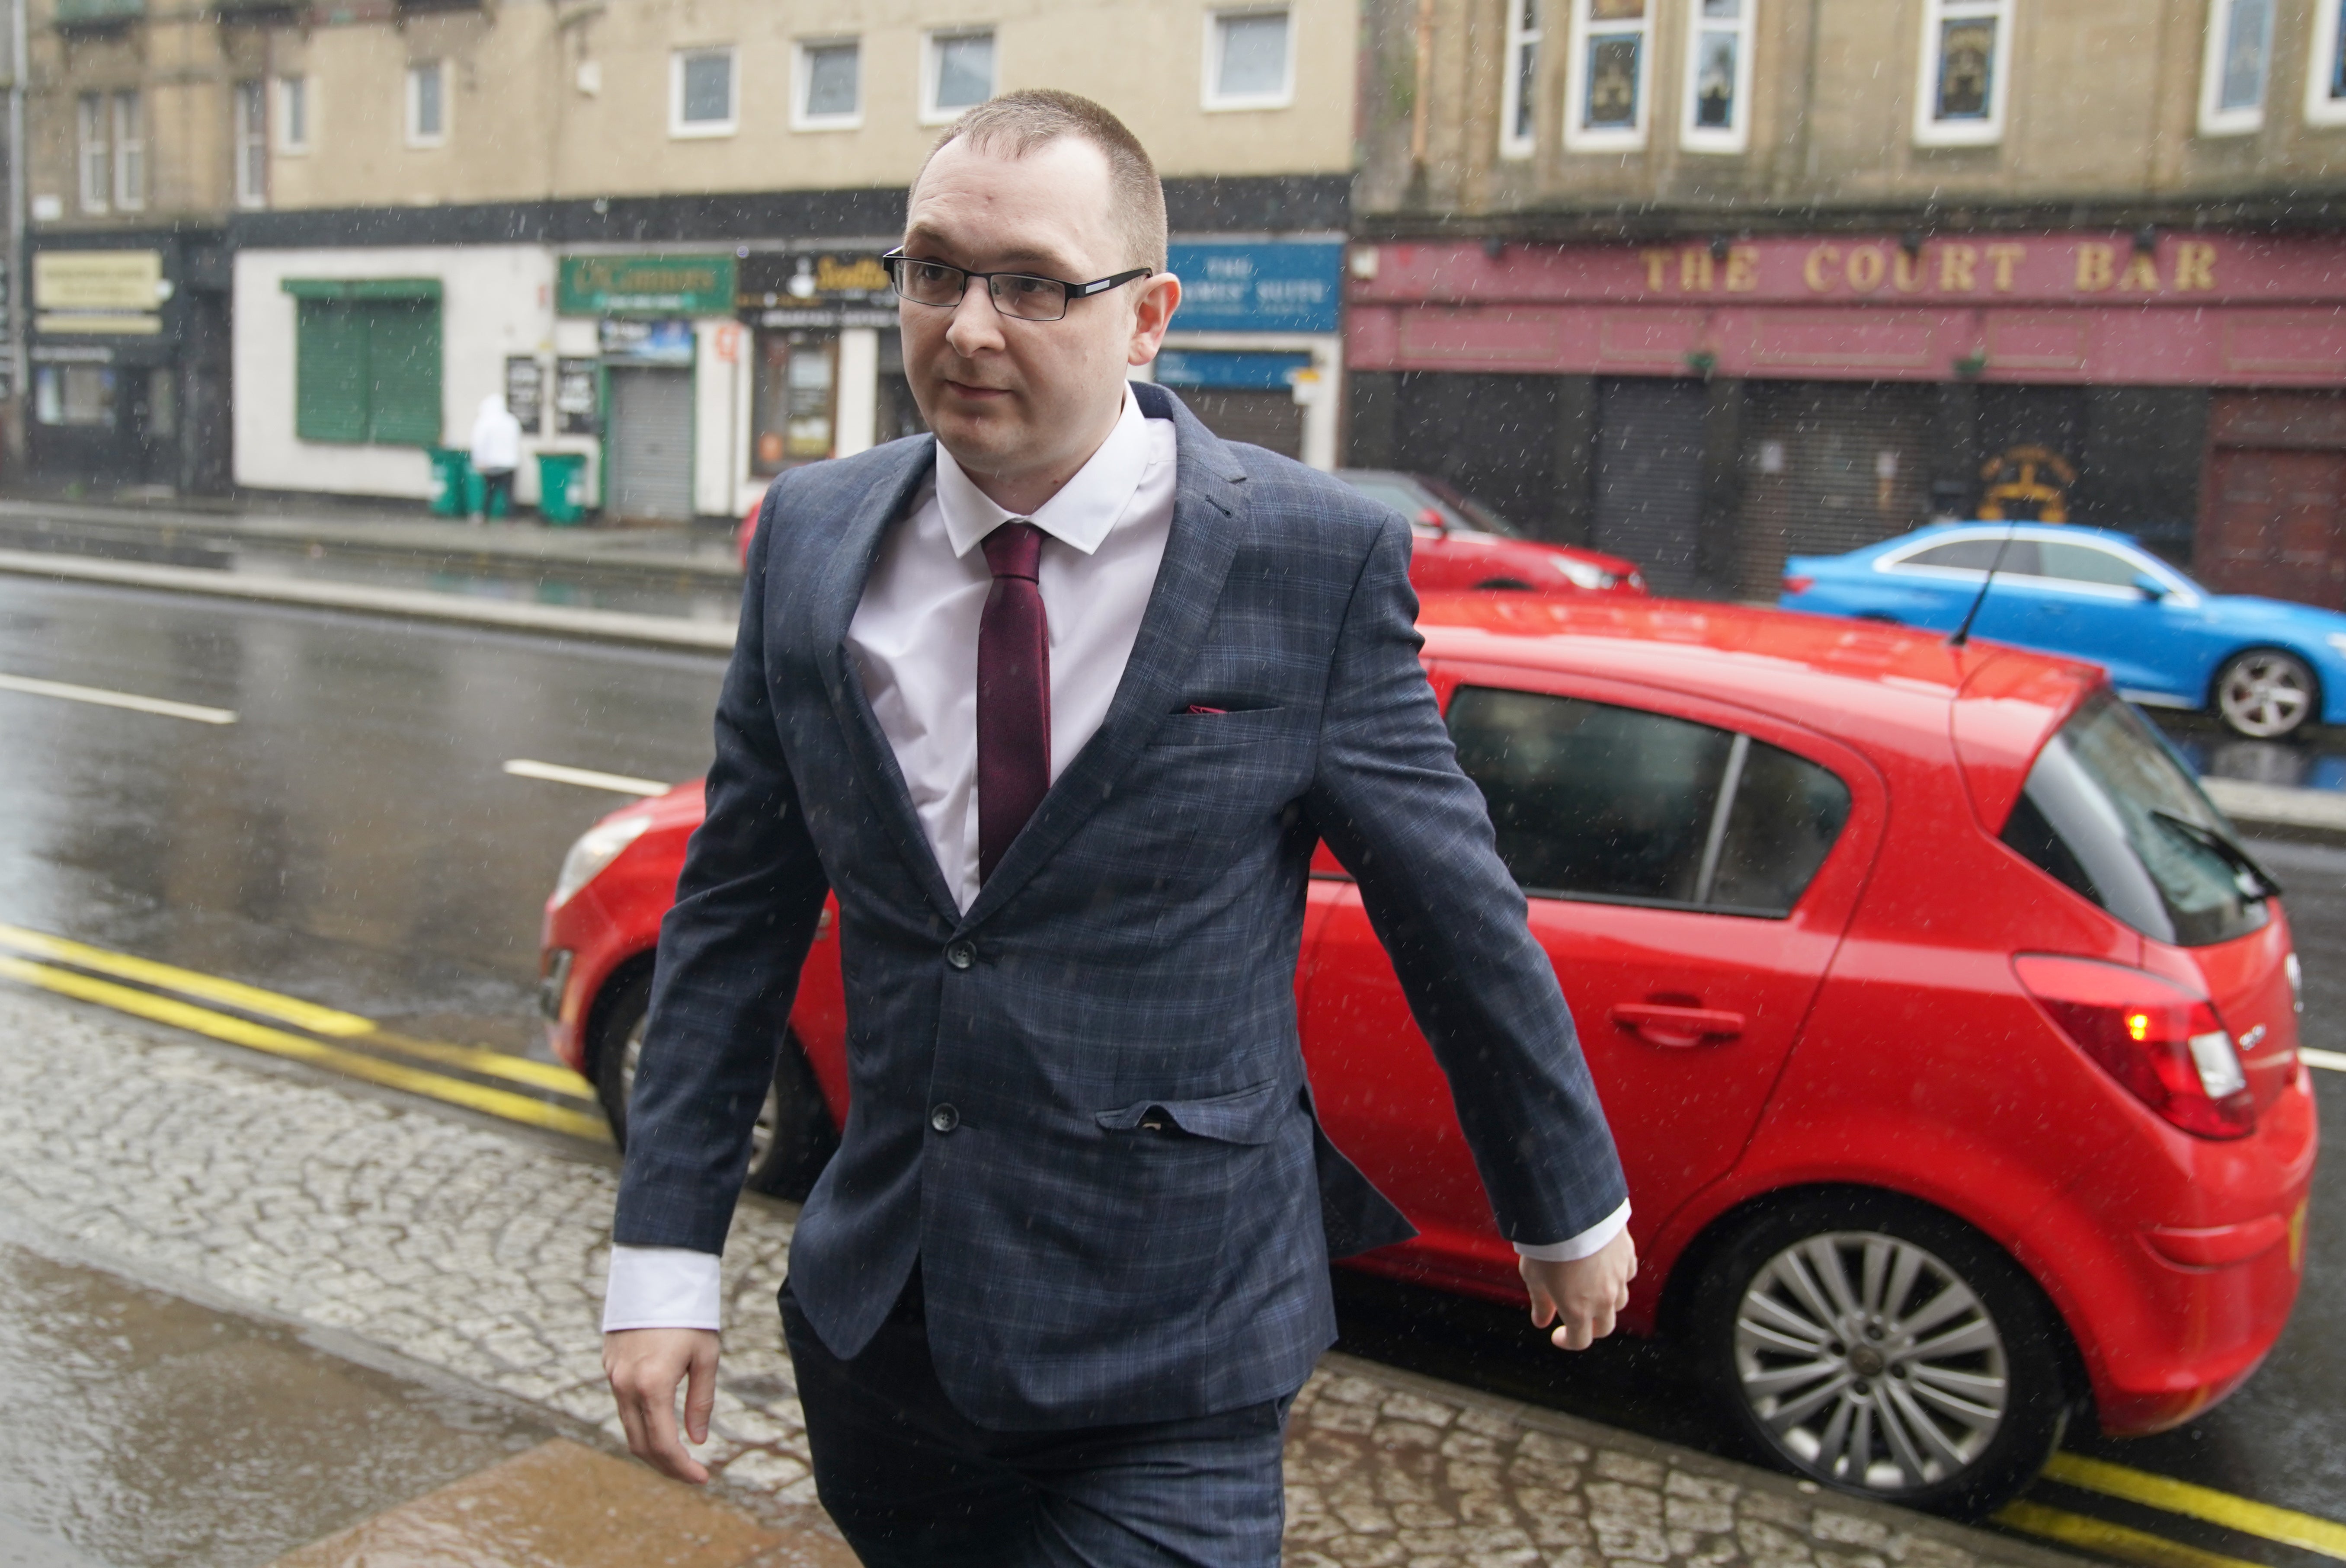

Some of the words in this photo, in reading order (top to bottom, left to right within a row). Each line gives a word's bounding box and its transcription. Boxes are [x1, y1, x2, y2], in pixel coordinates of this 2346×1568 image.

[1641, 245, 1760, 293] THE
[1803, 243, 2028, 294] COURT
[2075, 240, 2219, 292] BAR
